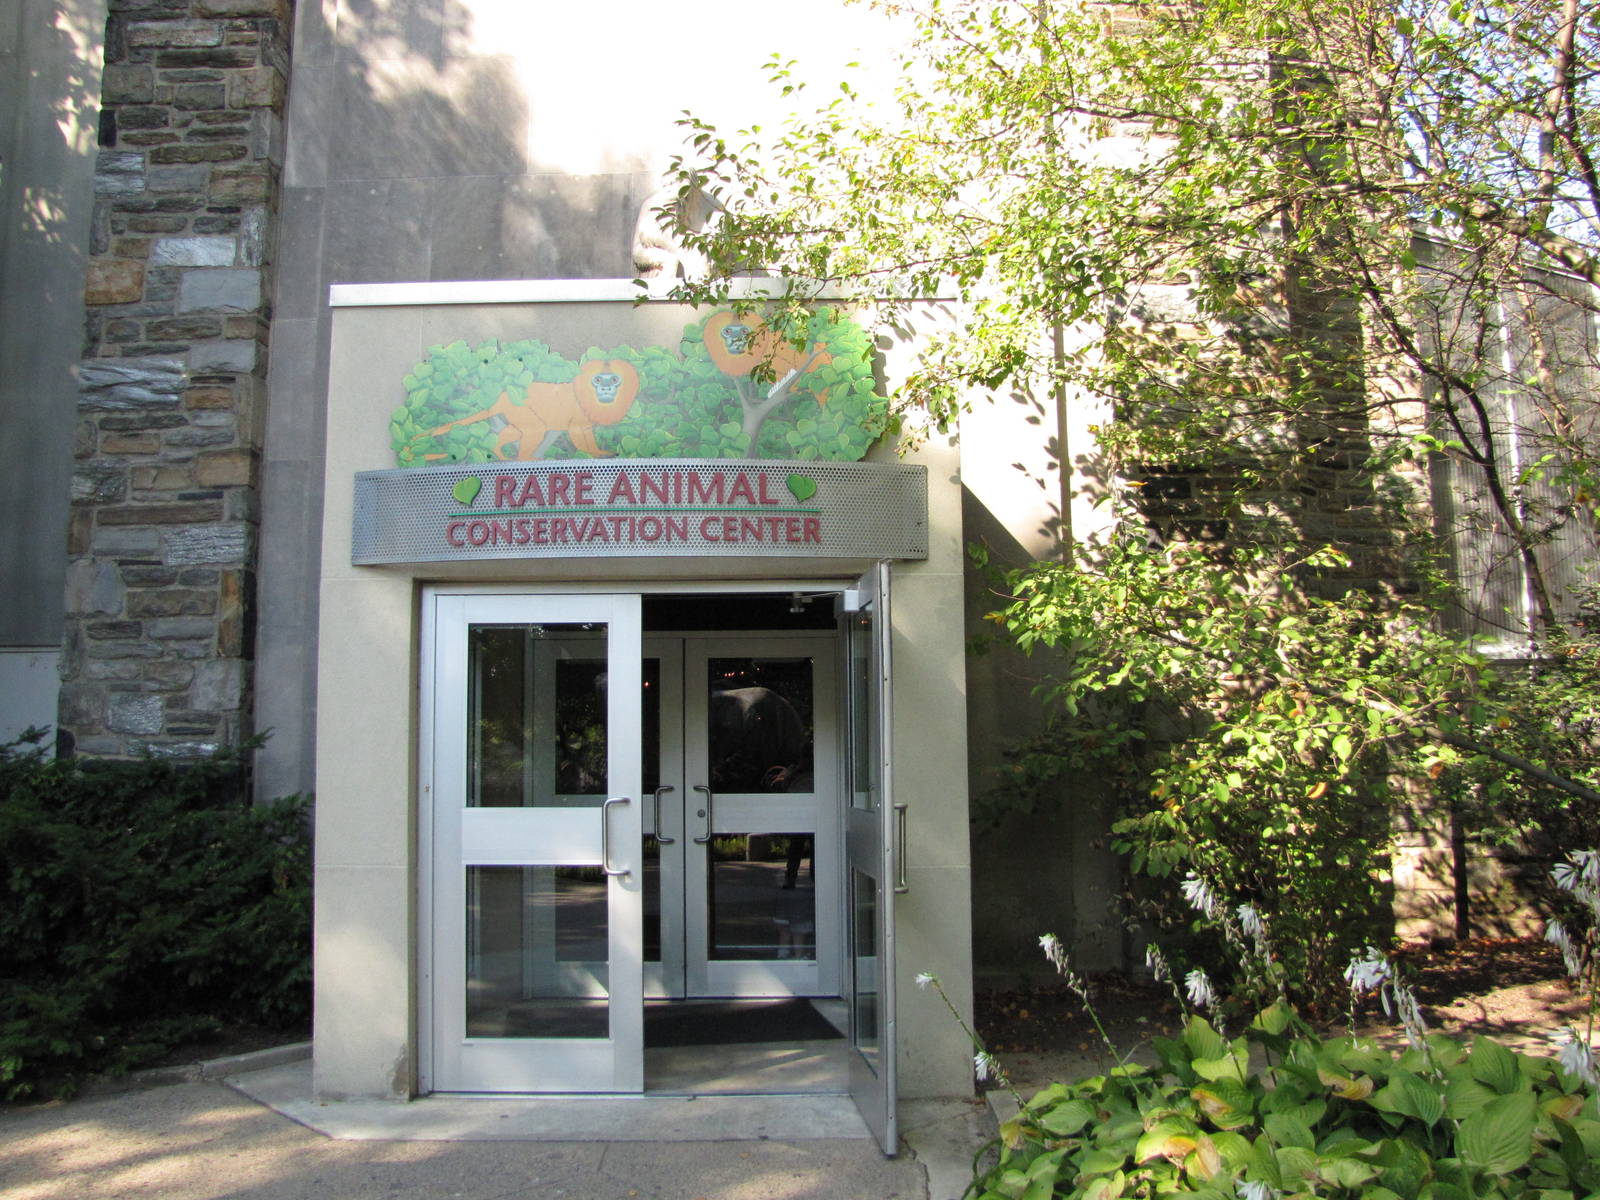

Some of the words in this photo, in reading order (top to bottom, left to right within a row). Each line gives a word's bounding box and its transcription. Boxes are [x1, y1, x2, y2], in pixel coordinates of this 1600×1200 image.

[495, 472, 596, 509] RARE
[606, 471, 780, 506] ANIMAL
[446, 517, 689, 547] CONSERVATION
[700, 515, 822, 543] CENTER
